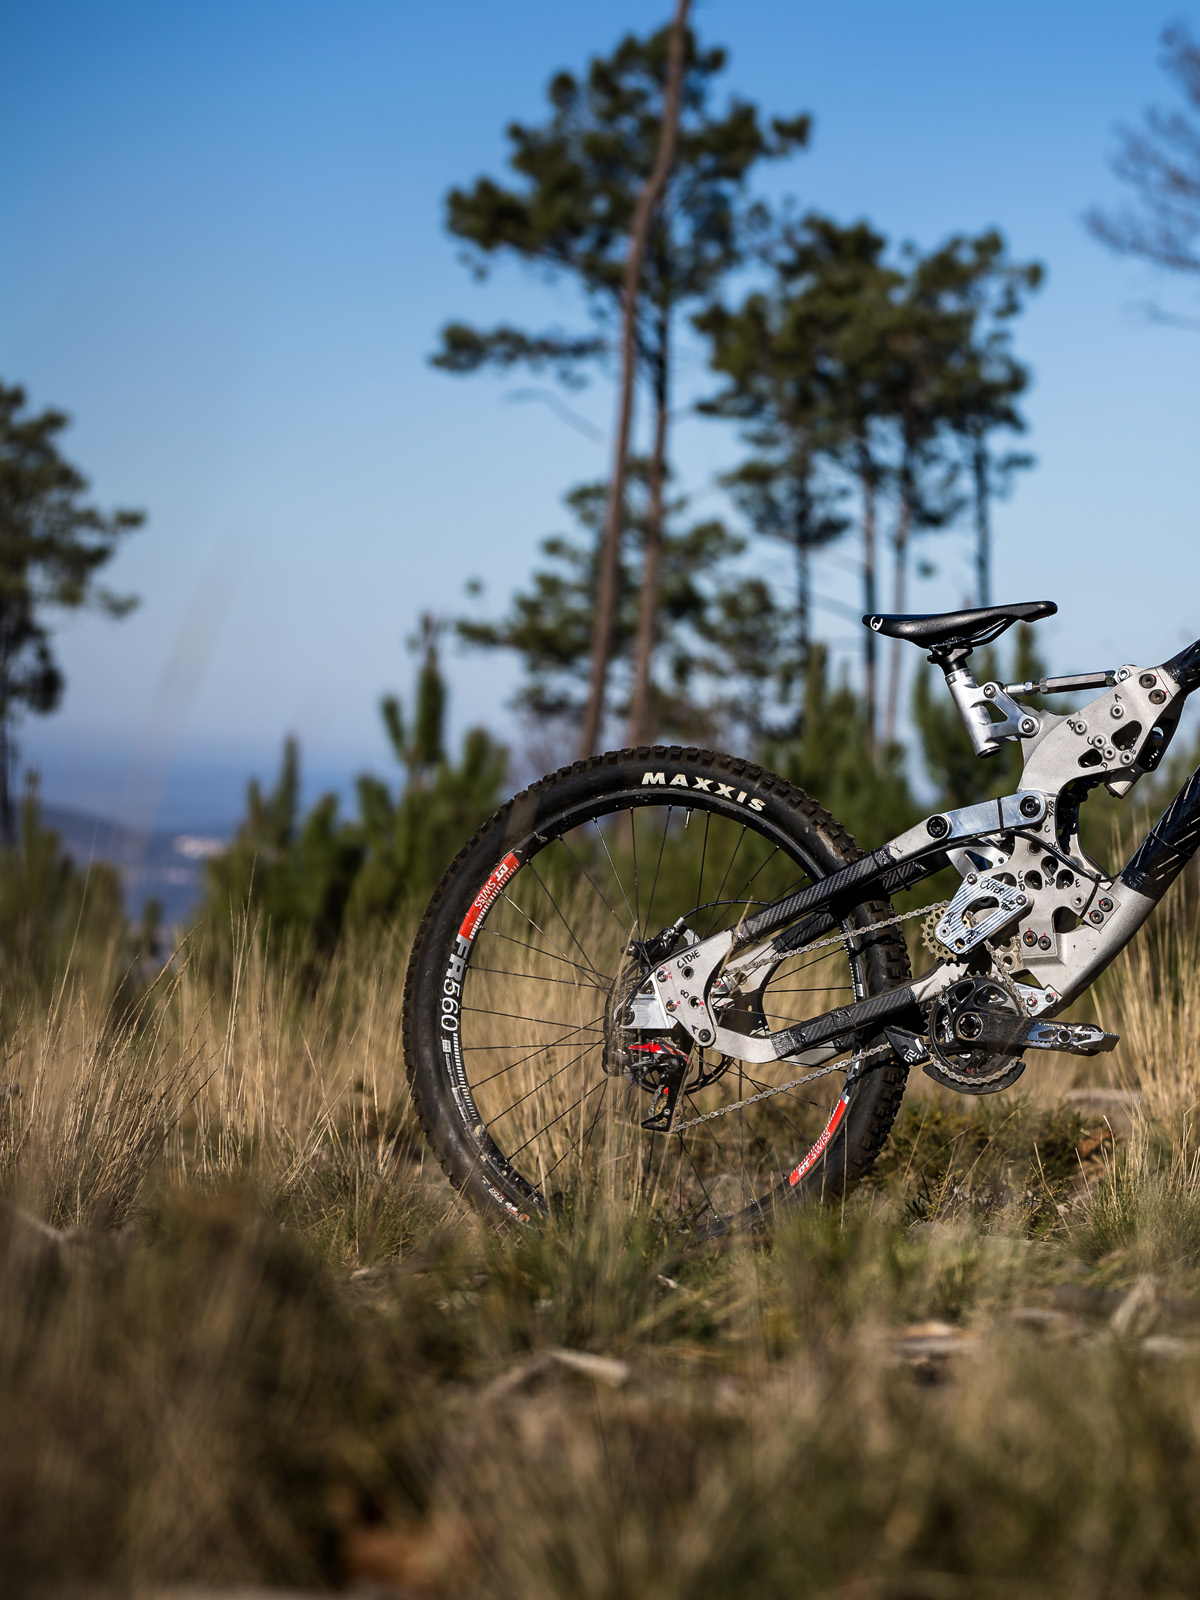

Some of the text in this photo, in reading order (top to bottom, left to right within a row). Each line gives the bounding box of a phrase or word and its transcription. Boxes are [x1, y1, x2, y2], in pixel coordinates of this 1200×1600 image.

[1114, 693, 1121, 702] A
[1066, 718, 1076, 731] B
[641, 772, 766, 812] MAXXIS
[474, 863, 509, 909] DT SWISS
[441, 934, 473, 1032] FR560
[810, 1129, 831, 1160] SWISS
